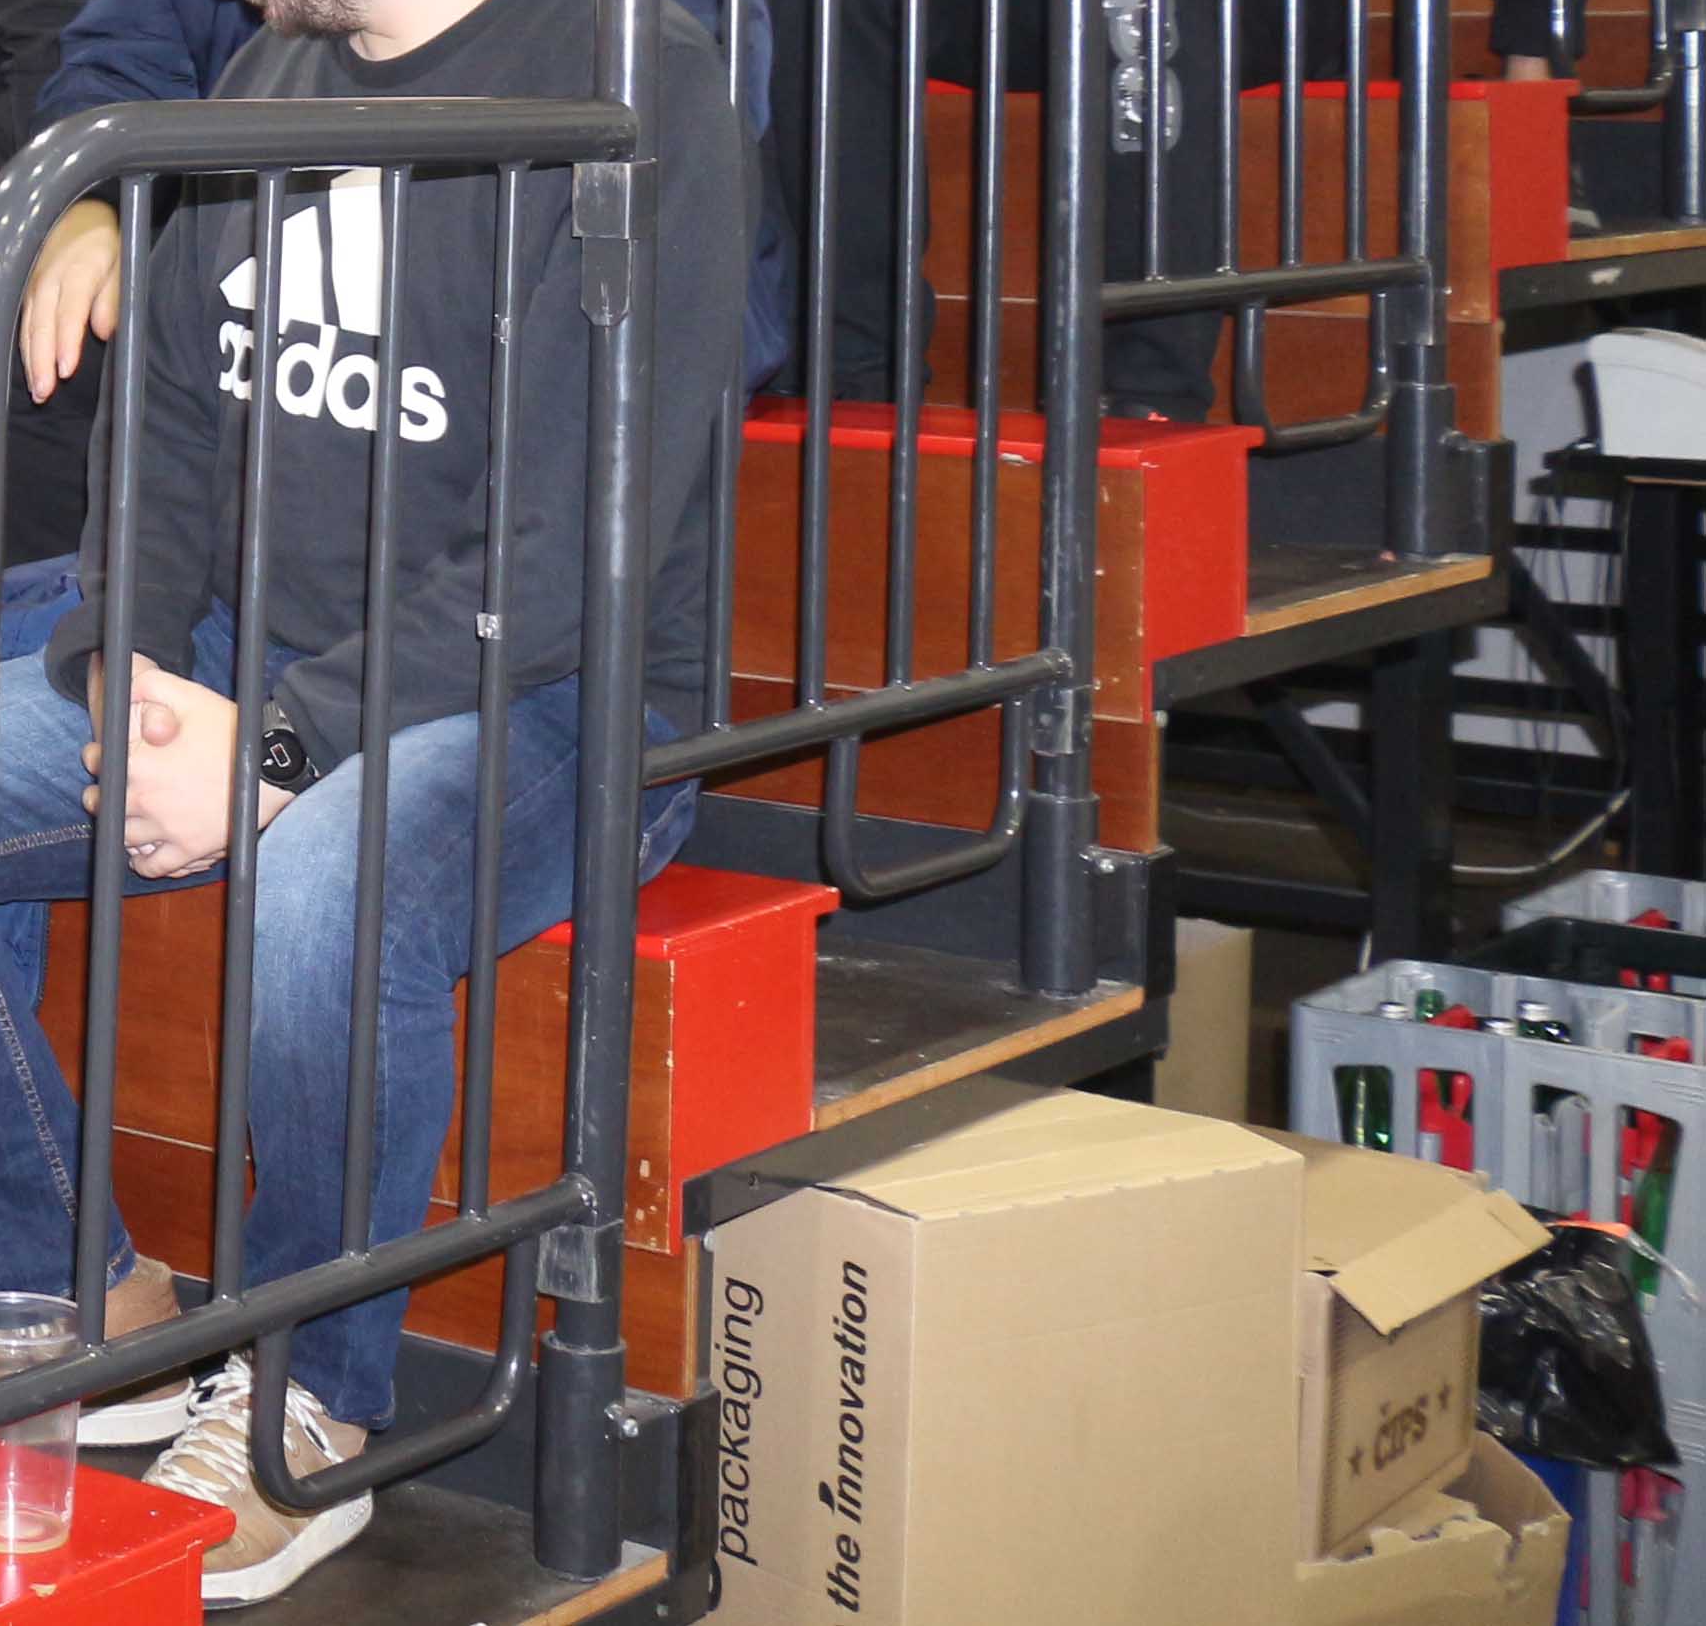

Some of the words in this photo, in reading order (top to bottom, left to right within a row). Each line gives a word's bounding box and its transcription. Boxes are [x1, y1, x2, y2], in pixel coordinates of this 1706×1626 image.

[219, 320, 448, 442] adas
[715, 1276, 764, 1566] packaging
[818, 1260, 868, 1525] innovation
[826, 1533, 862, 1613] the
